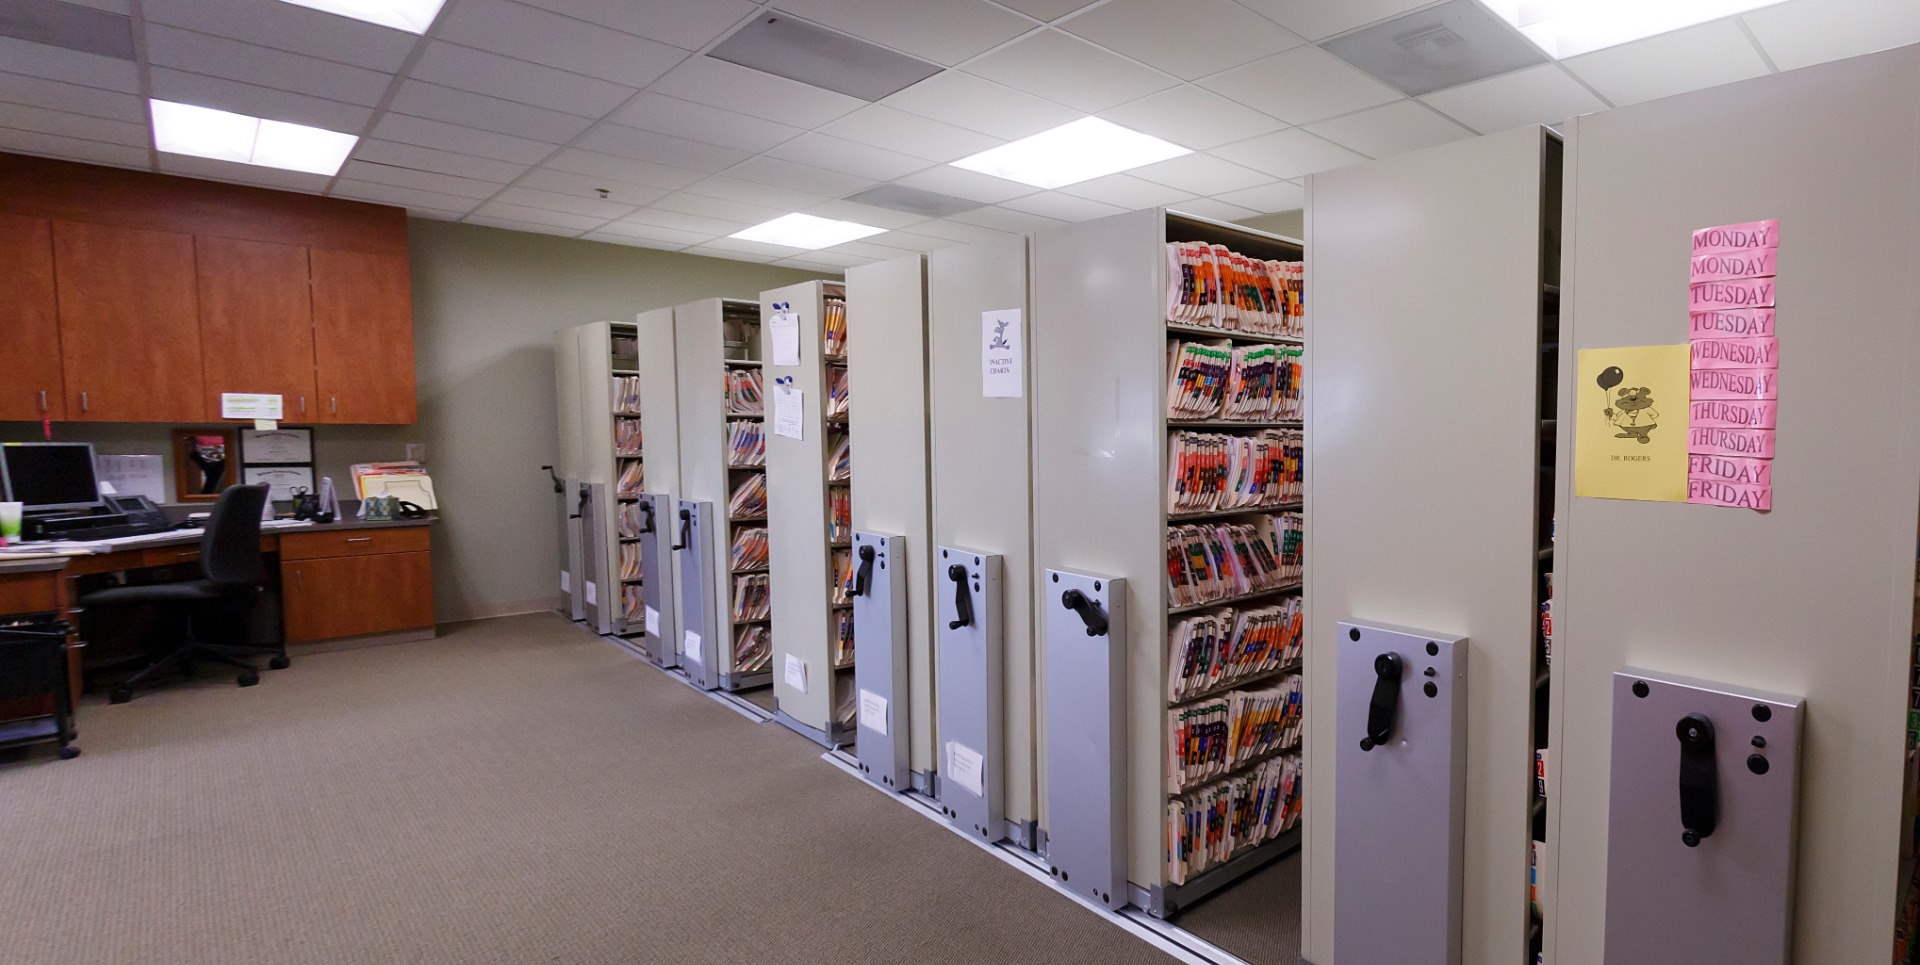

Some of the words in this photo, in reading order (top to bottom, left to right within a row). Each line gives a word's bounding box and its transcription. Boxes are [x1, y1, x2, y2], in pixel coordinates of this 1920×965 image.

[1693, 228, 1771, 251] MONDAY
[1691, 254, 1768, 276] MONDAY
[1690, 281, 1771, 305] TUESDAY
[1691, 312, 1771, 335] TUESDAY
[1691, 341, 1773, 365] WEDNESDAY
[1691, 371, 1773, 395] WEDNESDAY
[1692, 402, 1768, 427] THURSDAY
[1691, 429, 1766, 453] THURSDAY
[1688, 456, 1767, 484] FRIDAY
[1688, 480, 1767, 508] FRIDAY
